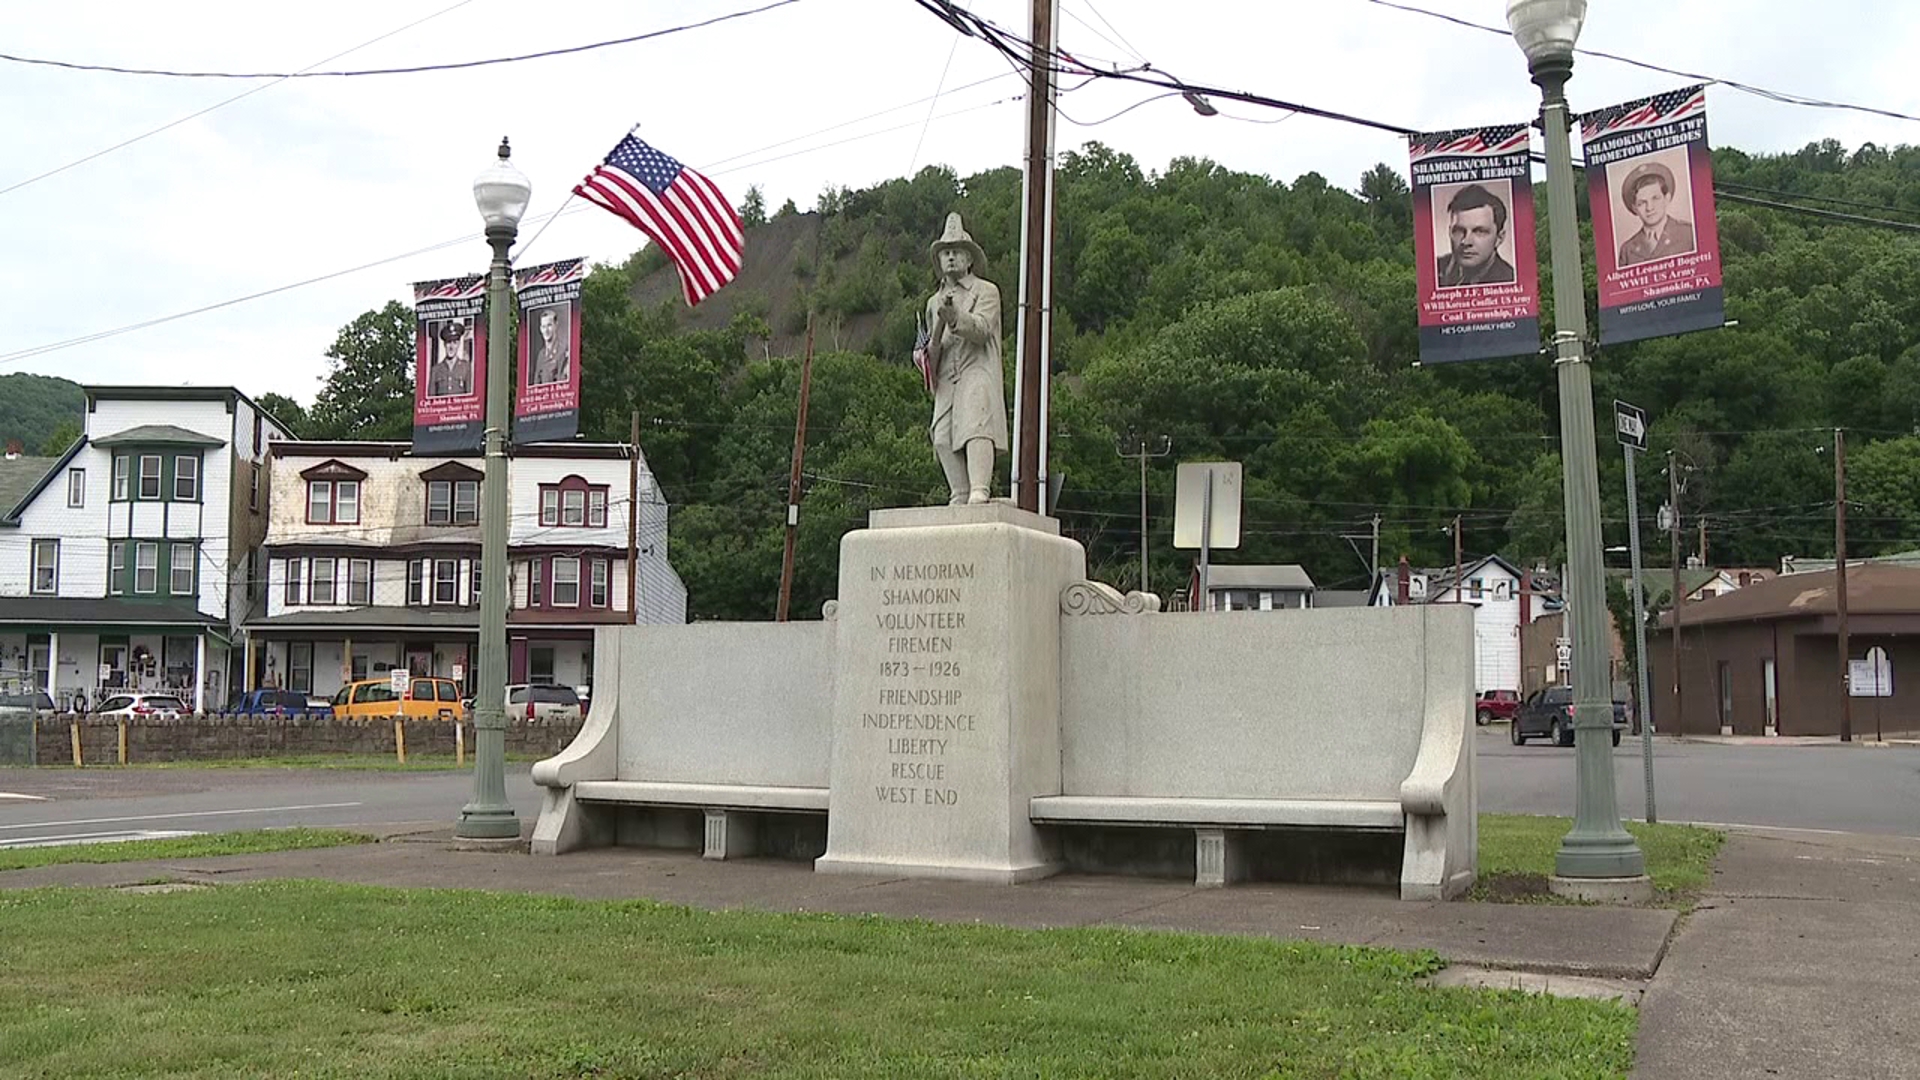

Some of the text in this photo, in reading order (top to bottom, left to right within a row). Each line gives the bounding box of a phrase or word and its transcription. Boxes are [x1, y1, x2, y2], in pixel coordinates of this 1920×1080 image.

[1586, 118, 1704, 155] SHAMOKIN/COAL TWP
[1590, 129, 1702, 165] HOMETOWN HEROES
[1413, 155, 1527, 174] SHAMOKIN/COAL TWP
[1416, 166, 1525, 184] HOMETOWN HEROES
[1605, 269, 1634, 282] Albert
[1636, 260, 1675, 276] Leonard
[1620, 267, 1696, 289] WWII US Army
[1430, 289, 1462, 300] Joseph
[1643, 276, 1710, 297] Shamokin, PA
[1501, 296, 1511, 304] US
[1512, 296, 1531, 304] Army
[1620, 306, 1637, 315] WITH
[1657, 297, 1677, 308] YOUR
[1677, 293, 1702, 304] FAMILY
[1441, 307, 1528, 321] Coal Township, PA
[1456, 325, 1471, 333] OUR
[1472, 323, 1496, 331] FAMILY
[1497, 321, 1516, 330] HERO
[870, 563, 975, 581] IN MEMORIAM
[882, 588, 961, 606] SHAMOKIN
[877, 613, 966, 630] VOLUNTEER
[889, 637, 952, 653] FIREMEN
[879, 690, 962, 706] FRIENDSHIP
[862, 713, 976, 731] INDEPENDENCE
[889, 738, 948, 755] LIBERTY
[892, 763, 945, 780] RESCUE
[876, 786, 958, 806] WEST END
